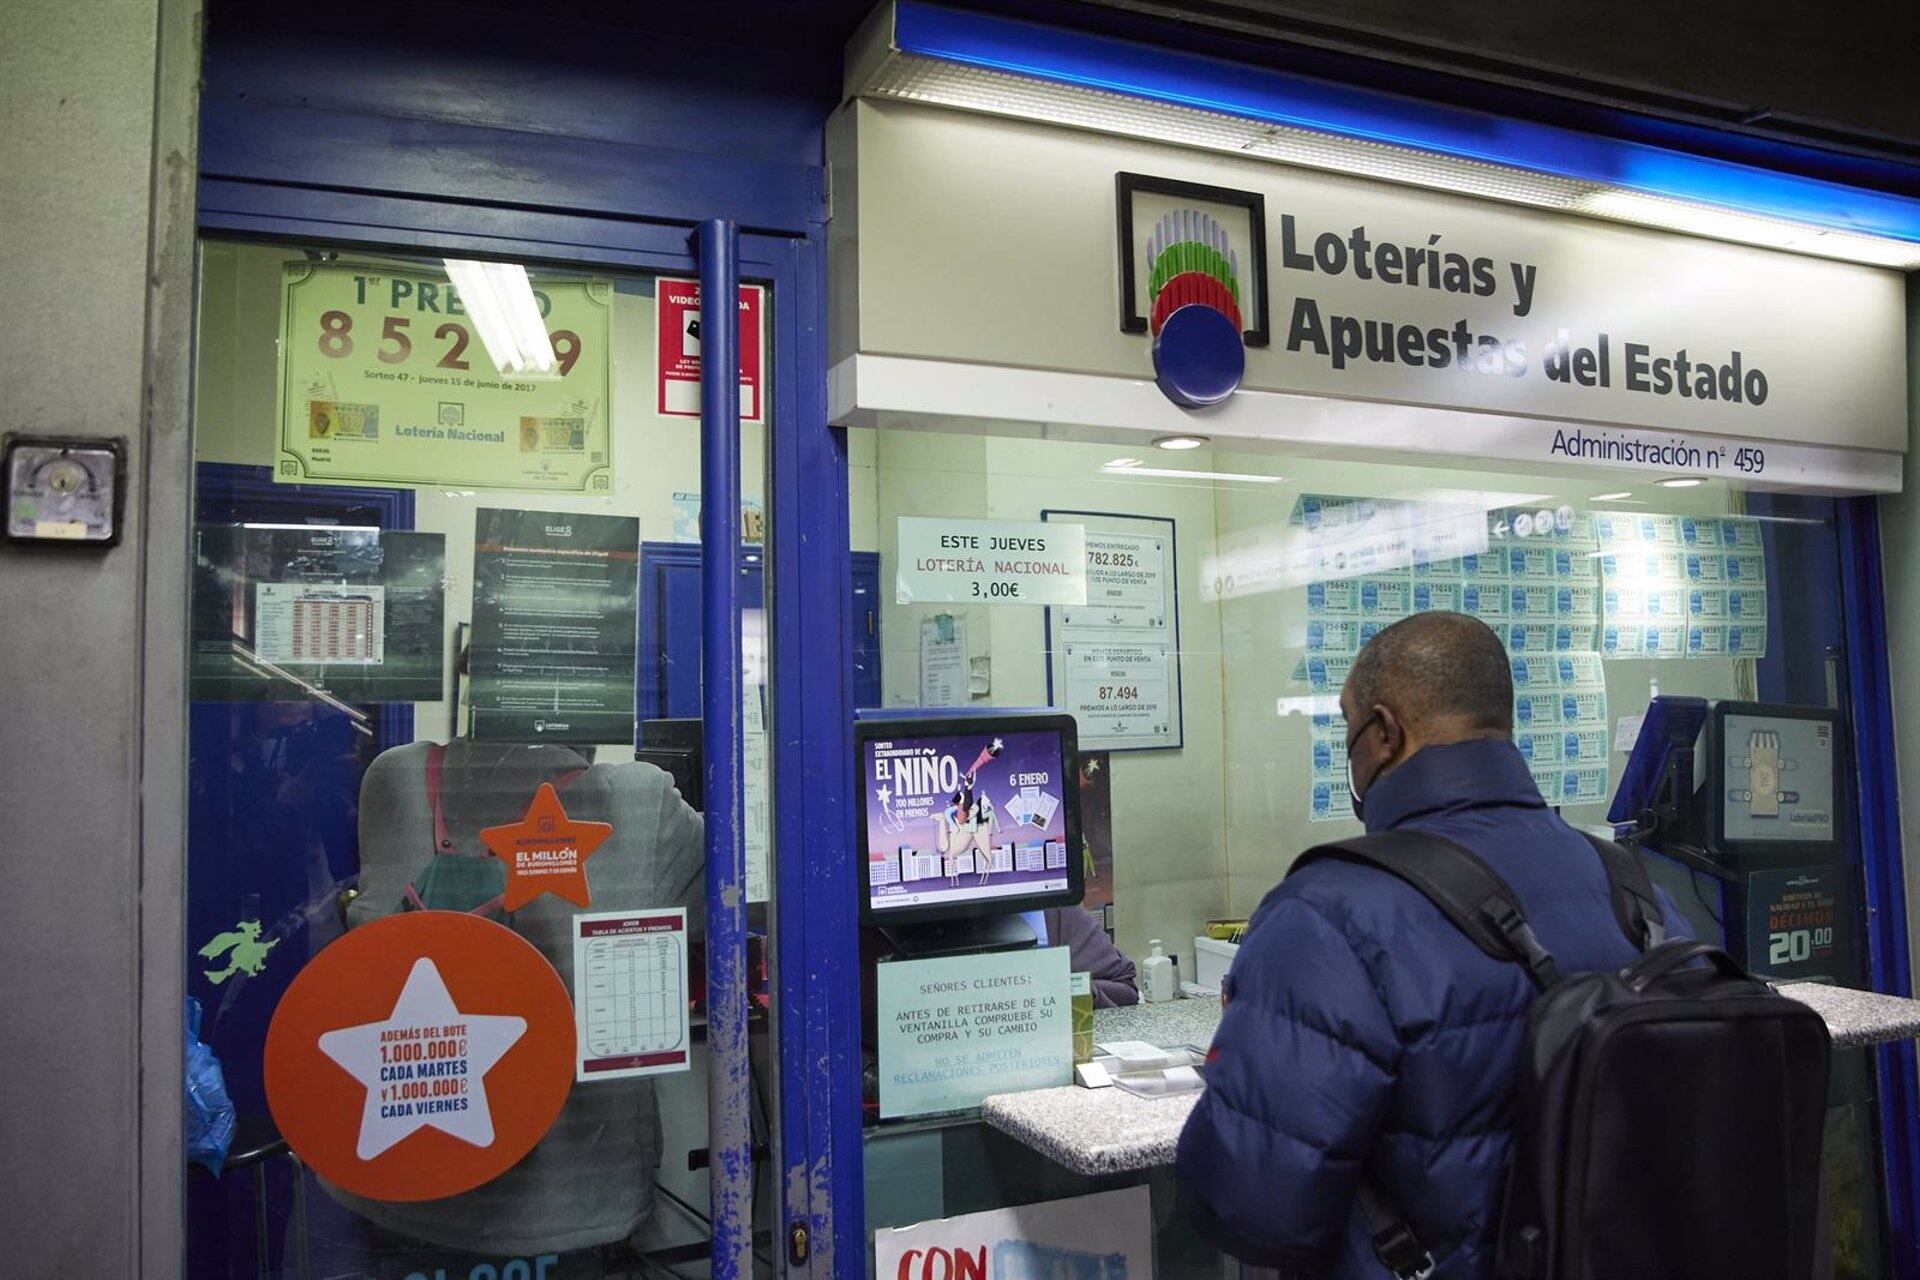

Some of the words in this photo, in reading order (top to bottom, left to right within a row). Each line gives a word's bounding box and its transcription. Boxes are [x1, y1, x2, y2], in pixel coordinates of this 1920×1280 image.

[1281, 214, 1496, 297] Loterías
[1510, 262, 1537, 316] y
[1286, 297, 1528, 378] Apuestas
[1544, 328, 1610, 388] del
[1624, 342, 1768, 406] Estado
[364, 369, 395, 382] Sorteo
[396, 373, 409, 382] 47
[418, 375, 449, 386] jueves
[451, 377, 463, 387] 15
[463, 378, 476, 388] de
[476, 379, 500, 390] junio
[501, 381, 513, 391] de
[514, 382, 537, 393] 2017
[395, 424, 445, 440] Lotería
[447, 427, 506, 444] Nacional
[1551, 429, 1700, 468] Administración
[1733, 446, 1765, 474] 459
[941, 535, 979, 549] ESTE
[989, 537, 1046, 551] JUEVES
[917, 557, 985, 573] LOTERÍA
[995, 561, 1069, 575] NACIONAL
[1088, 551, 1134, 567] 782.825
[972, 582, 1019, 599] 3,00€
[1099, 686, 1138, 700] 87.494
[874, 742, 893, 750] SORTEO
[875, 759, 892, 781] EL
[894, 748, 959, 796] NIÑO
[1009, 774, 1017, 786] 6
[1018, 772, 1049, 786] ENERO
[907, 796, 934, 807] MILLONES
[516, 852, 531, 862] EL
[532, 846, 577, 861] MILLÓN
[920, 980, 967, 995] SEÑORES
[973, 974, 1032, 989] CLIENTES:
[896, 1010, 930, 1022] ANTES
[937, 1007, 950, 1017] DE
[958, 999, 1017, 1016] RETIRARSE
[1023, 998, 1036, 1008] DE
[1043, 996, 1056, 1006] LA
[899, 1017, 968, 1034] VENTANILLA
[975, 1011, 1034, 1026] COMPRUEBE
[1040, 1009, 1053, 1019] SU
[381, 1027, 421, 1042] ADEMÁS
[423, 1028, 441, 1039] DEL
[443, 1025, 467, 1037] BOTE
[917, 1031, 958, 1044] COMPRA
[966, 1030, 971, 1040] Y
[978, 1027, 992, 1037] SU
[998, 1022, 1038, 1035] CAMBIO
[934, 1056, 949, 1067] NO
[956, 1054, 969, 1065] SE
[977, 1048, 1022, 1062] ADMITEN
[380, 1065, 413, 1082] CADA
[417, 1060, 468, 1078] MARTES
[894, 1065, 984, 1086] RECLAMACIONES
[989, 1056, 1060, 1073] POSTERIORES
[380, 1103, 413, 1119] CADA
[416, 1098, 468, 1115] VIERNES
